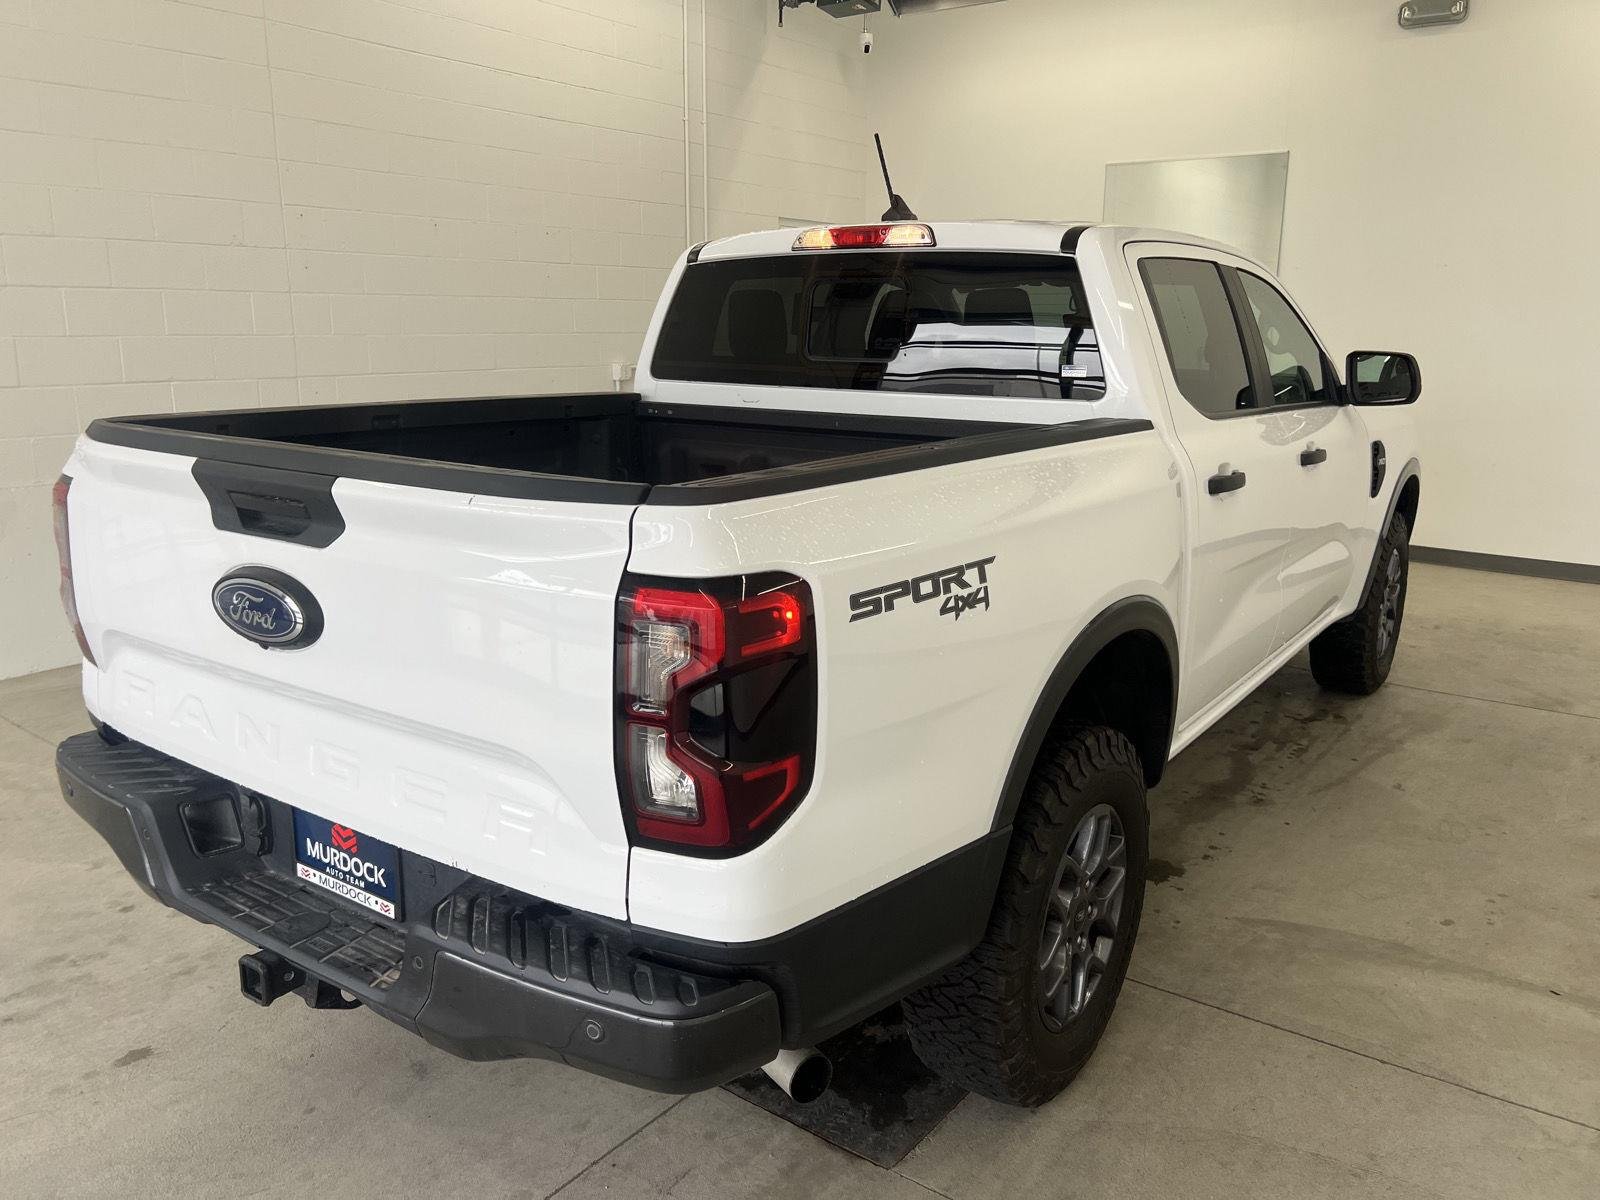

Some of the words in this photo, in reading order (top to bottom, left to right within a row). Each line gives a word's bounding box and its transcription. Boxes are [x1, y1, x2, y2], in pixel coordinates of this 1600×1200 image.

[229, 590, 277, 630] Ford
[849, 555, 996, 623] SPORT
[122, 668, 550, 857] RANGER
[306, 837, 387, 888] MURDOCK
[326, 866, 344, 880] AUTO
[346, 874, 365, 888] TEAM
[319, 874, 373, 906] MURDOCK
